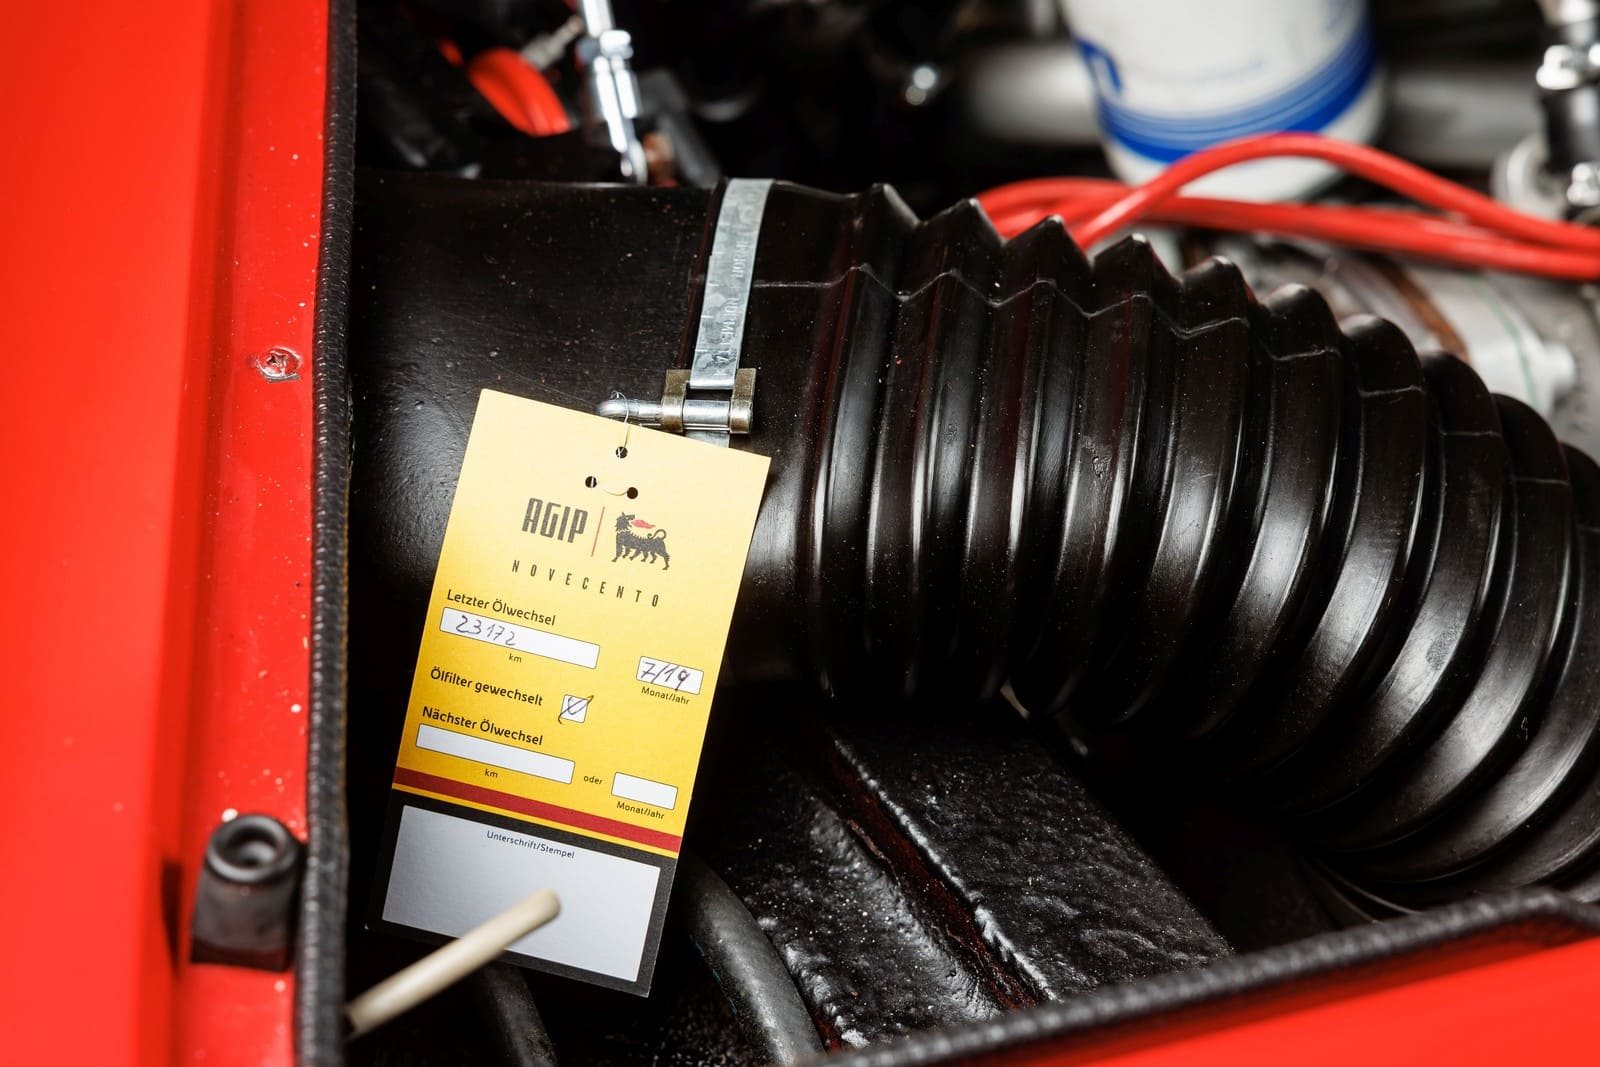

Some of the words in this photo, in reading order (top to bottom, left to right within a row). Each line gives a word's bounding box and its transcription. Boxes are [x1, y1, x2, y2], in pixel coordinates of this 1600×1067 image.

[521, 497, 588, 543] AGIP
[511, 559, 660, 608] NOVECENTO
[446, 588, 490, 610] Letzter
[491, 598, 556, 627] Ölwechsel
[455, 615, 516, 647] 23172
[508, 652, 522, 663] km
[430, 665, 473, 688] Ölfilter
[474, 682, 543, 706] gewechselt
[640, 661, 691, 691] 7/19
[640, 686, 691, 705] Monat/Jahr
[422, 705, 478, 730] Nächster
[479, 718, 544, 746] Ölwechsel
[484, 768, 499, 778] km
[583, 775, 604, 785] oder
[616, 800, 665, 820] Monat/Jahr
[486, 829, 575, 859] Unterschrift/Stempel
